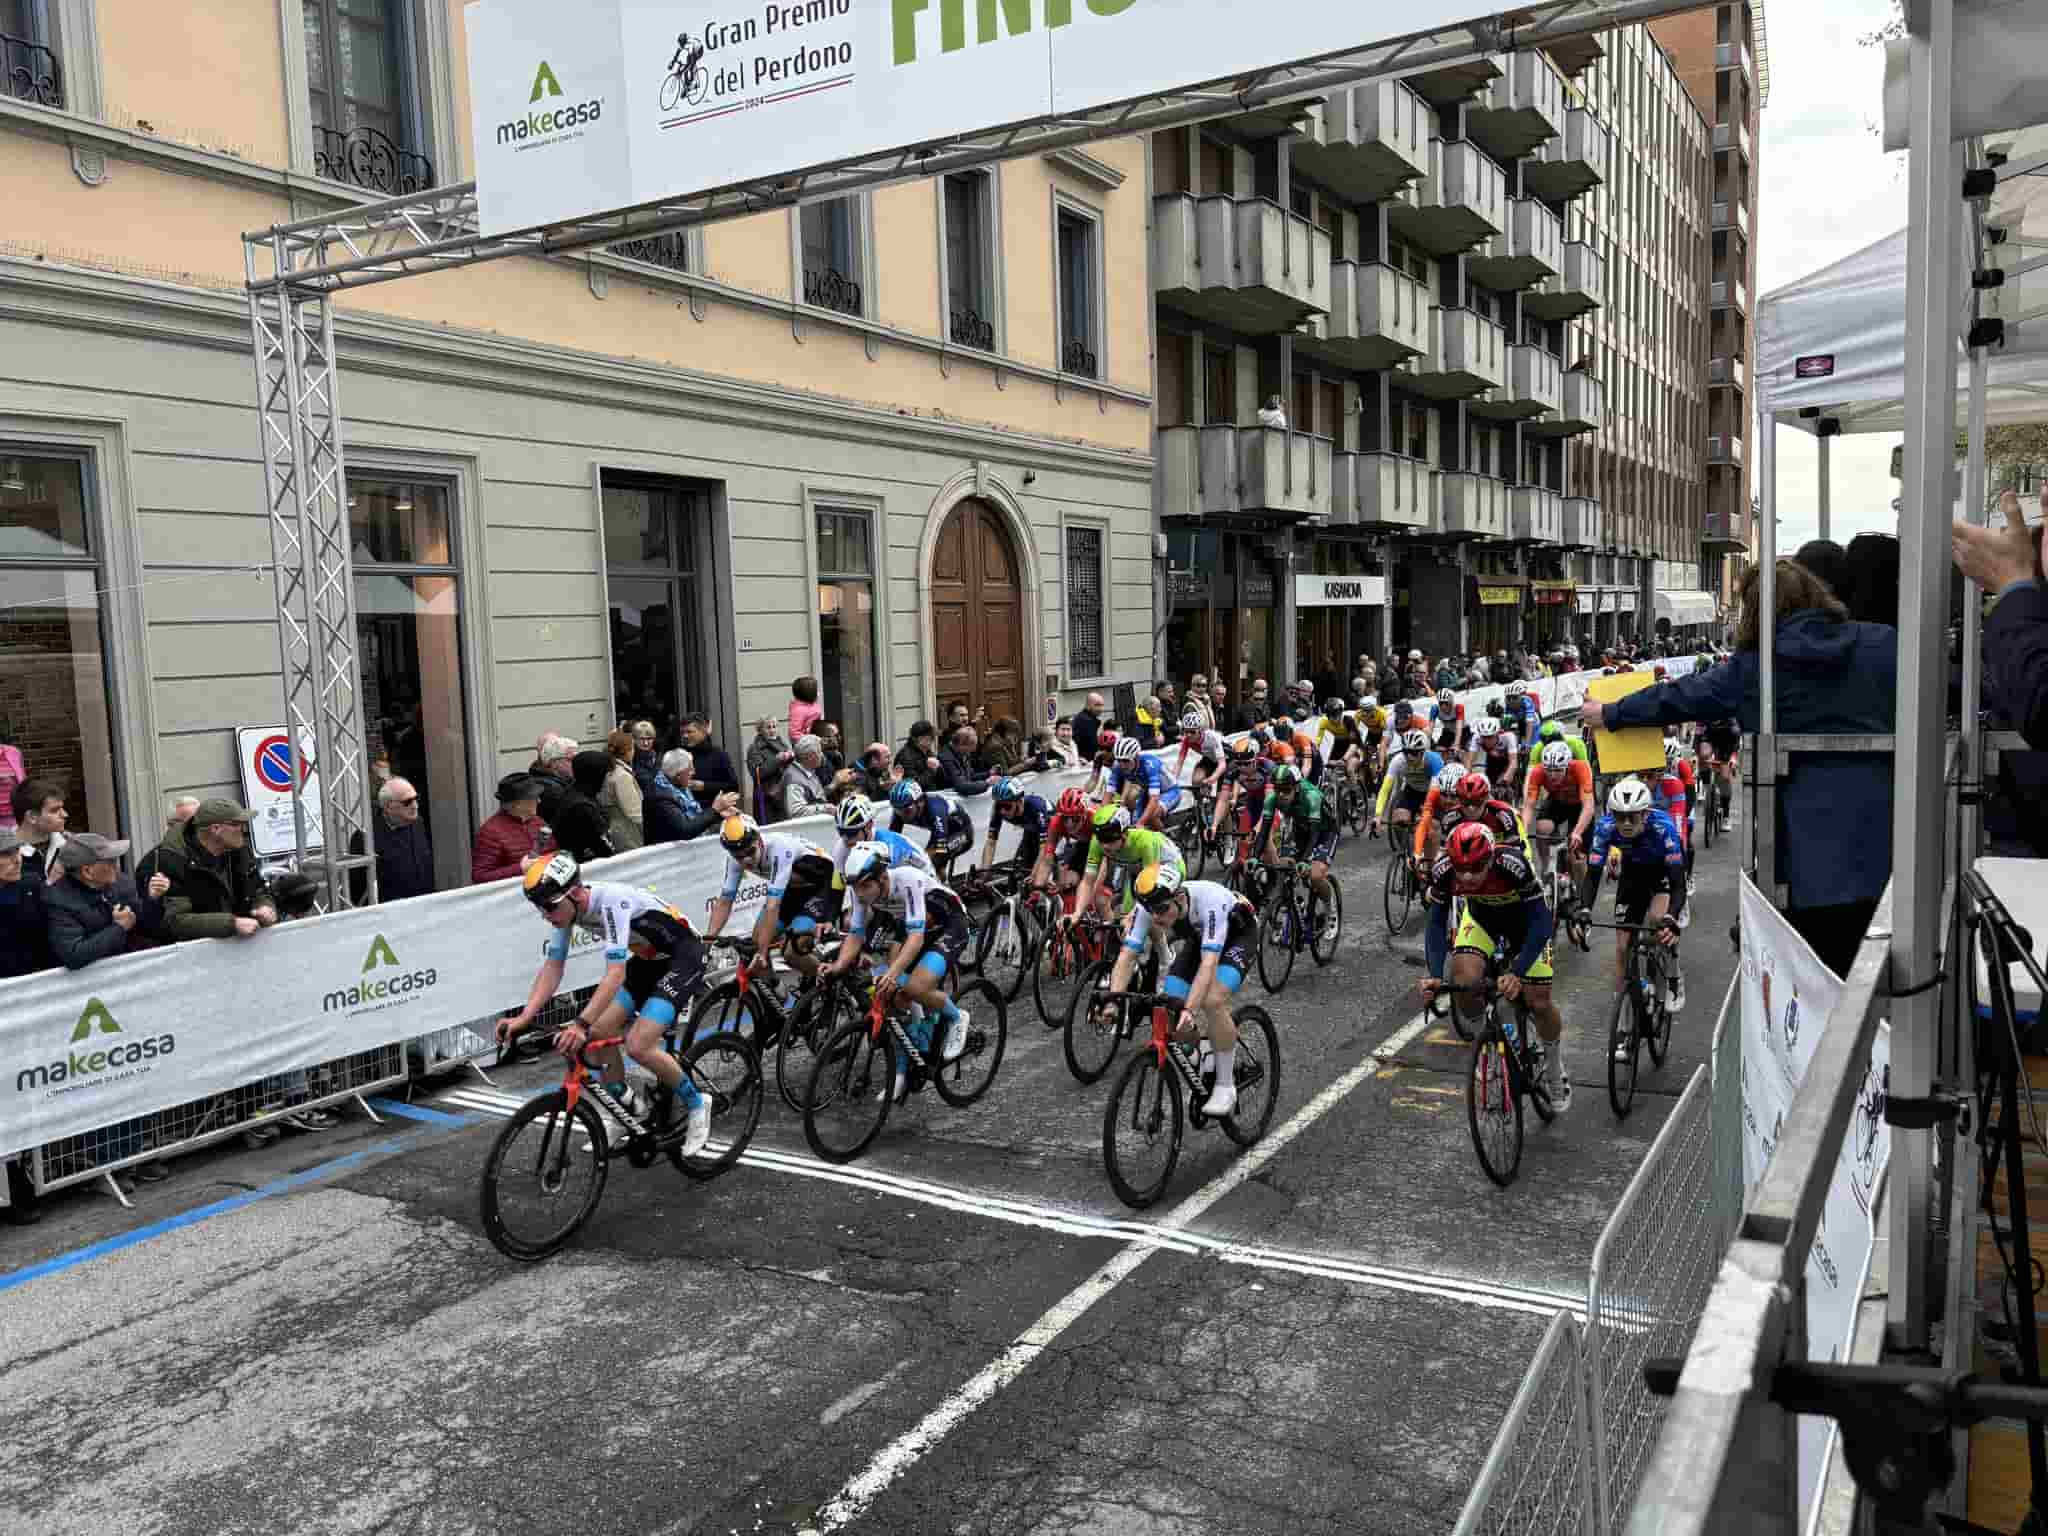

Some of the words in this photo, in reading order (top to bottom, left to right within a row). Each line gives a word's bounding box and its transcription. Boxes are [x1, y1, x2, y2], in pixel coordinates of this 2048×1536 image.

[704, 19, 756, 51] Gran
[766, 0, 850, 34] Premio
[714, 62, 744, 95] del
[754, 42, 851, 85] Perdono
[496, 100, 601, 144] makecasa
[1324, 582, 1362, 600] KASANOVA
[323, 968, 437, 1012] makecasa
[16, 1034, 175, 1092] makecasa
